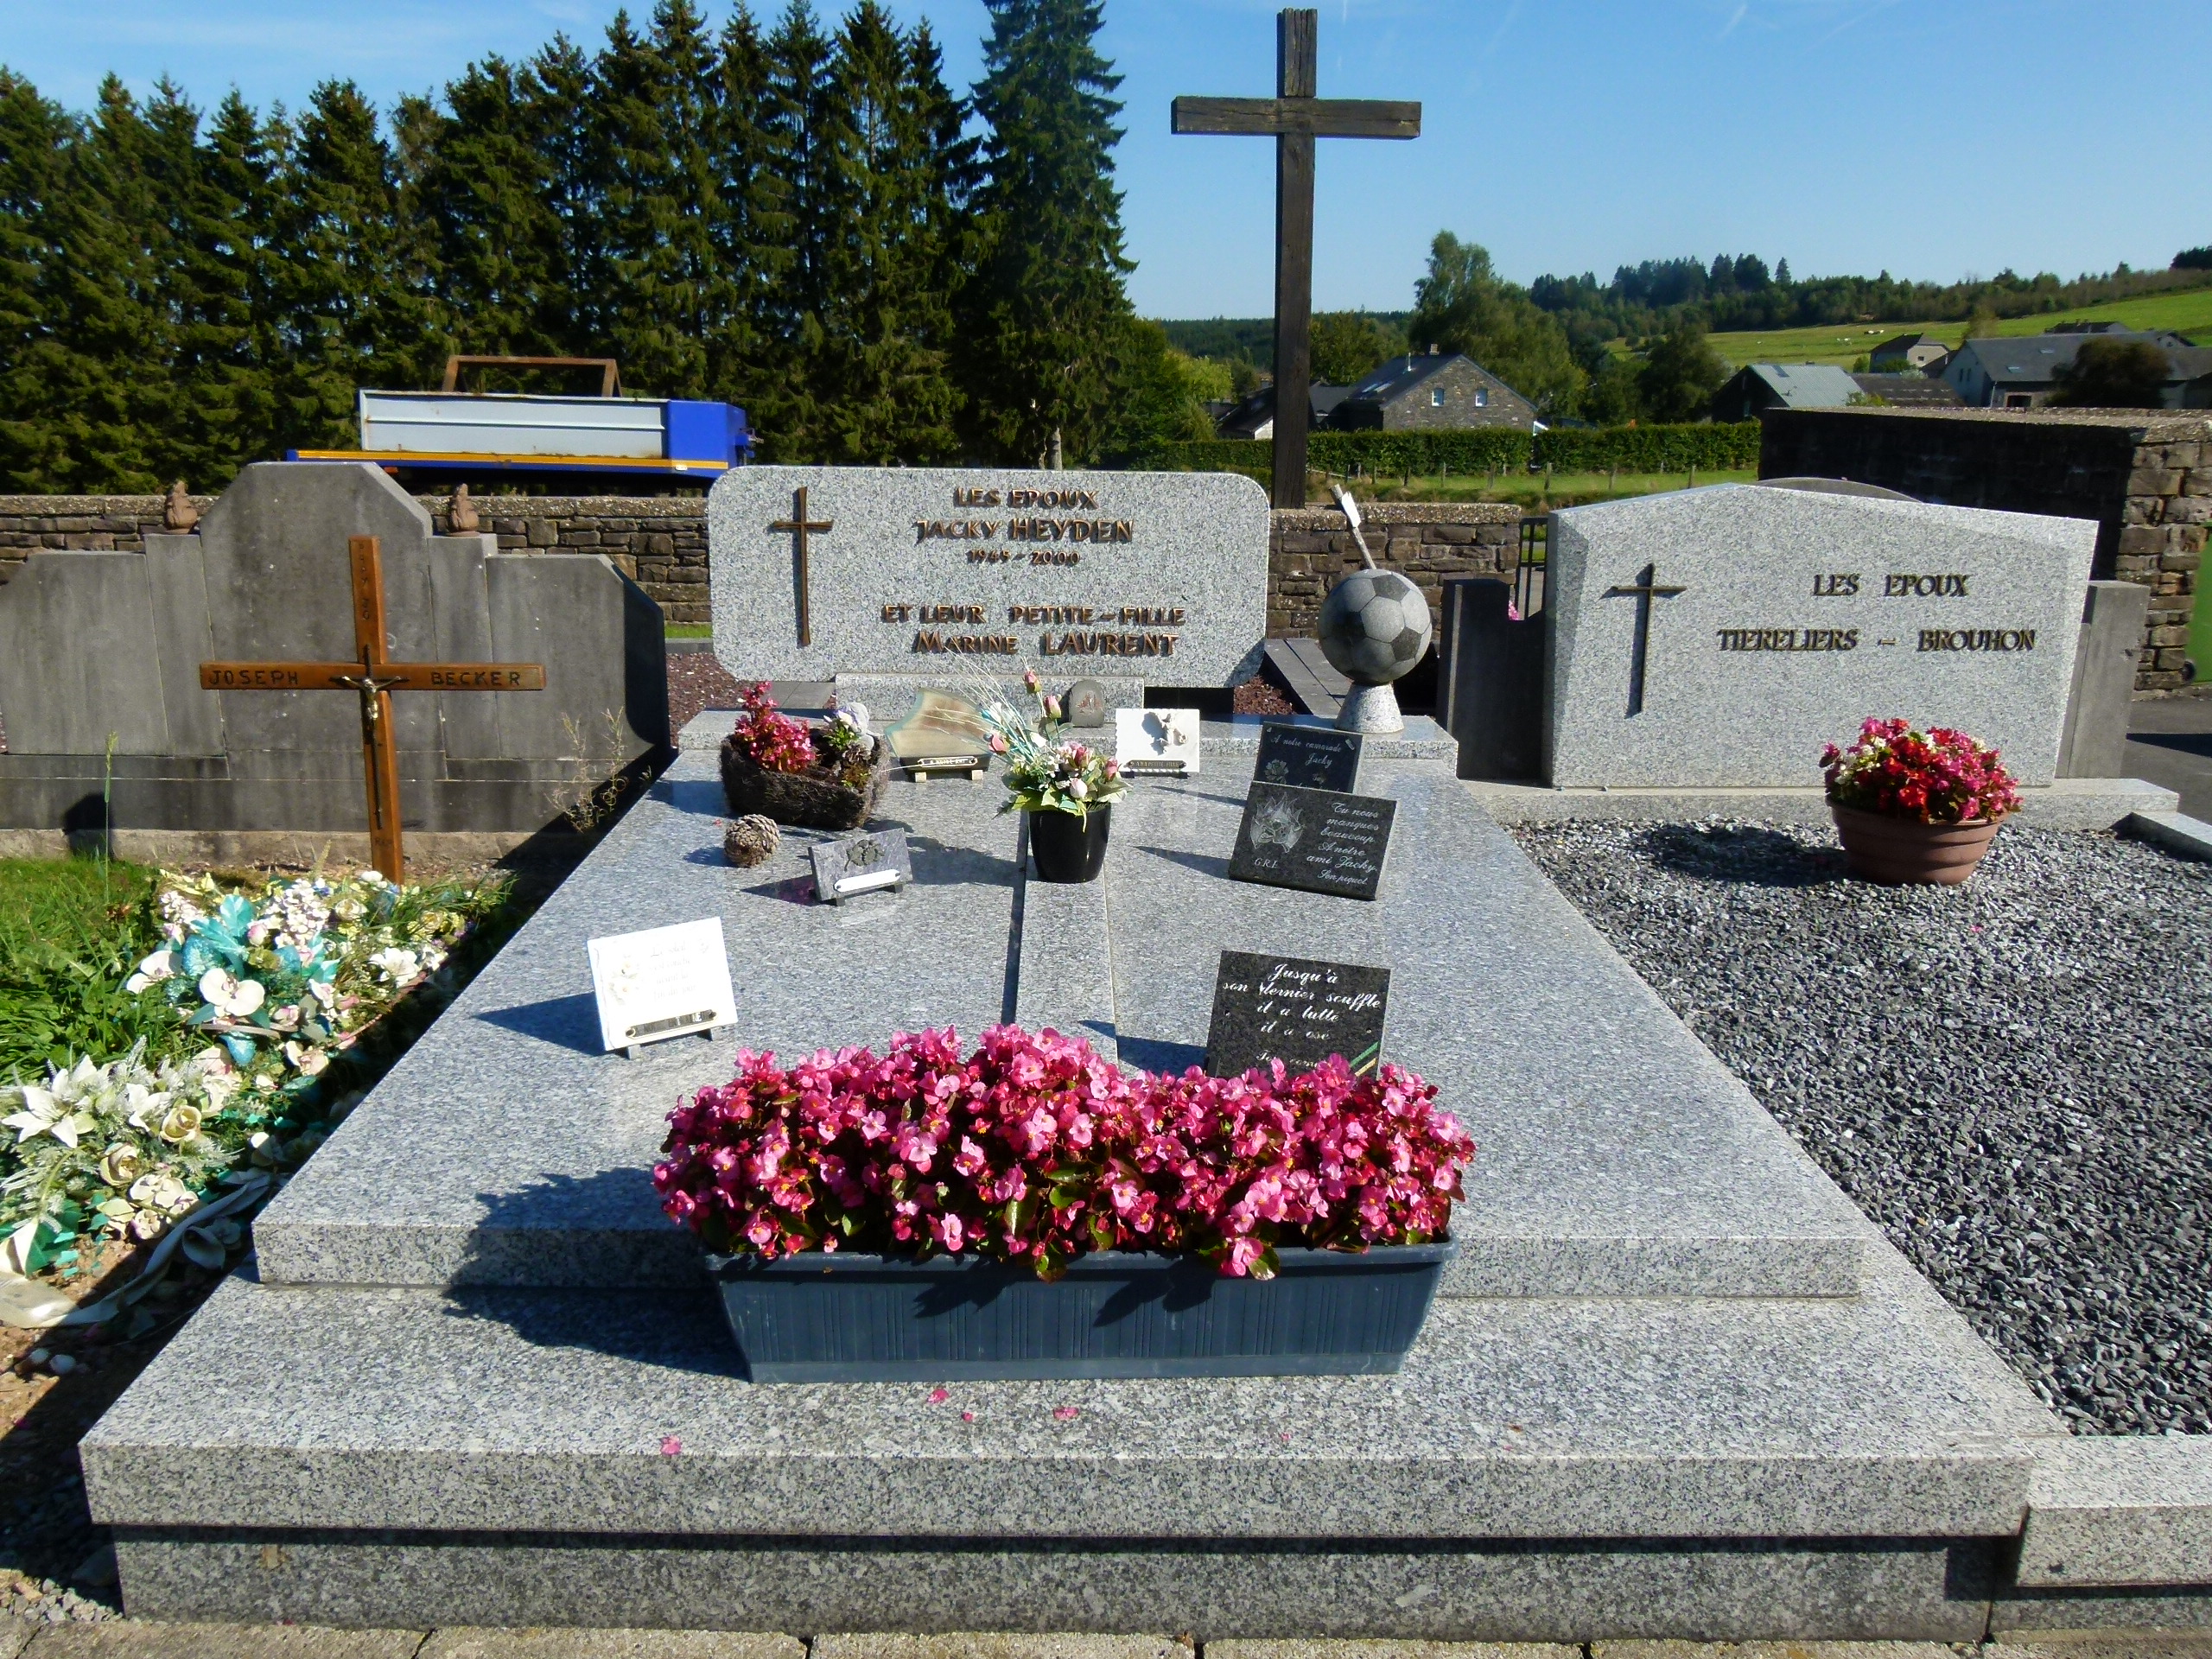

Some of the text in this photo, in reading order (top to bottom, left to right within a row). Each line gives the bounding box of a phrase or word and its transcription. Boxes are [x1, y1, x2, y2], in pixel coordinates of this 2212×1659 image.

[953, 486, 1099, 510] LES EPOUX
[913, 518, 1134, 543] JACKY HEYDEN
[1030, 549, 1081, 565] 2000
[1814, 573, 1971, 597] LES EPOUX
[881, 605, 909, 623] ET
[920, 605, 987, 624] LEUR
[912, 631, 1179, 656] MARINE LAURENT
[1716, 628, 1860, 652] TIERELIERS
[1916, 628, 2036, 652] BROUHON
[208, 670, 522, 687] JOSEPH BECKER
[1305, 753, 1332, 769] Jacky
[1351, 809, 1379, 818] nous
[1326, 817, 1379, 831] manques
[1306, 855, 1332, 865] ami
[1333, 846, 1366, 856] notre
[1268, 963, 1338, 986] Jusqu'à
[1223, 982, 1381, 1012] son dernier souffle
[1256, 1001, 1340, 1022] il a lutté
[1260, 1020, 1277, 1033] il
